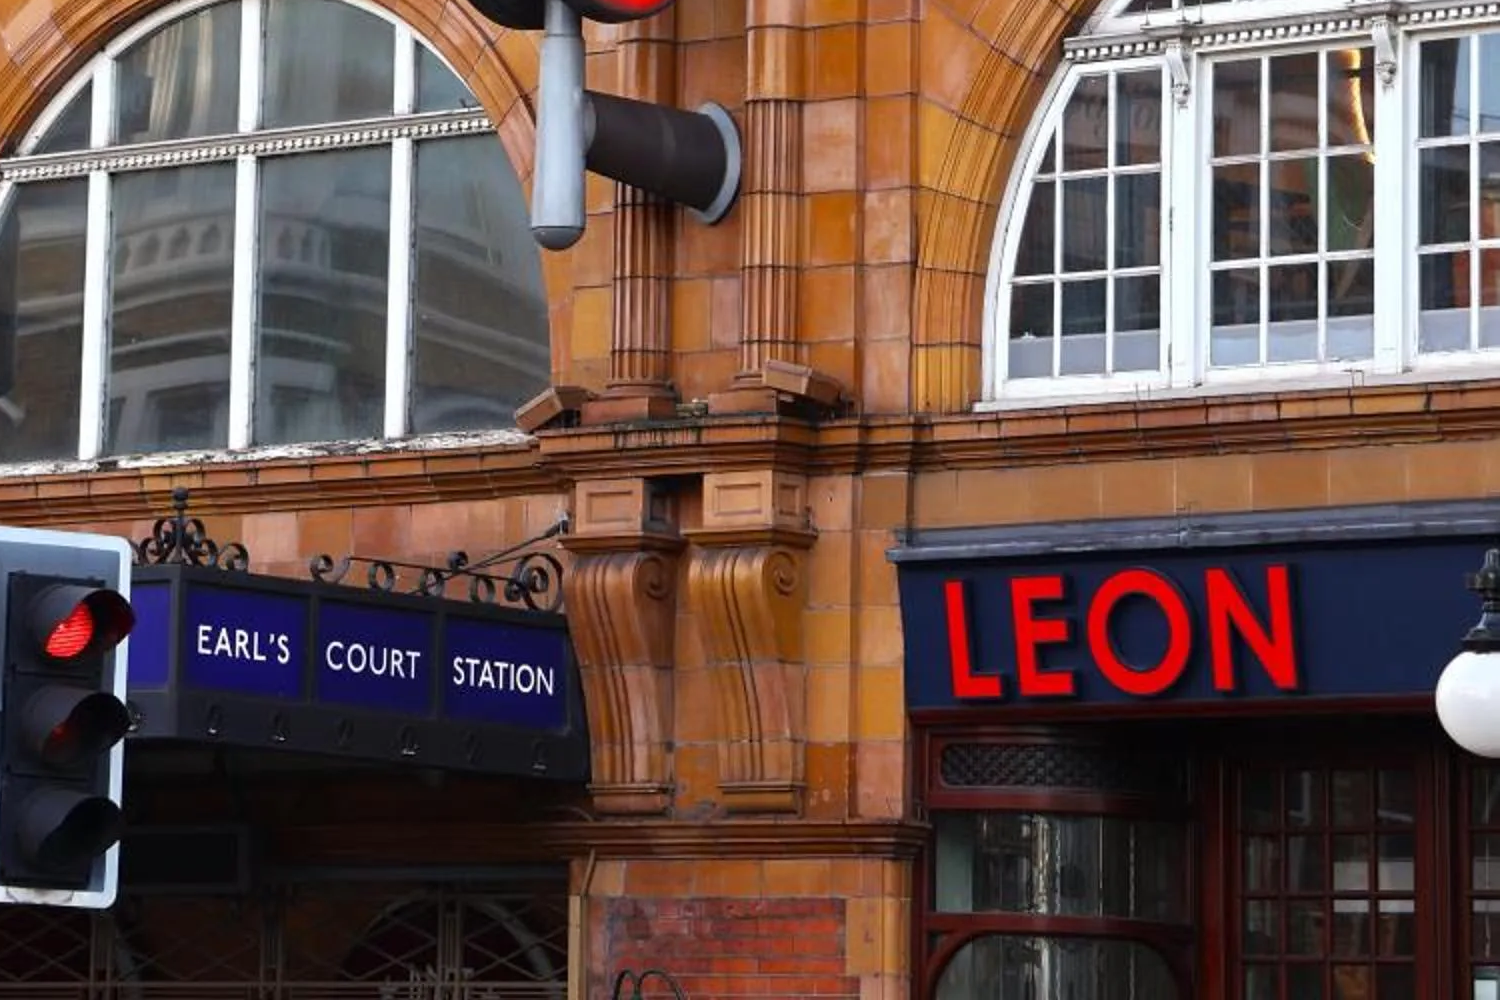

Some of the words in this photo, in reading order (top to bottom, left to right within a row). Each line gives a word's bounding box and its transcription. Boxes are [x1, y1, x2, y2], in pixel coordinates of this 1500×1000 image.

[197, 624, 291, 665] EARL'S
[325, 641, 421, 680] COURT
[452, 656, 555, 697] STATION
[944, 564, 1298, 698] LEON
